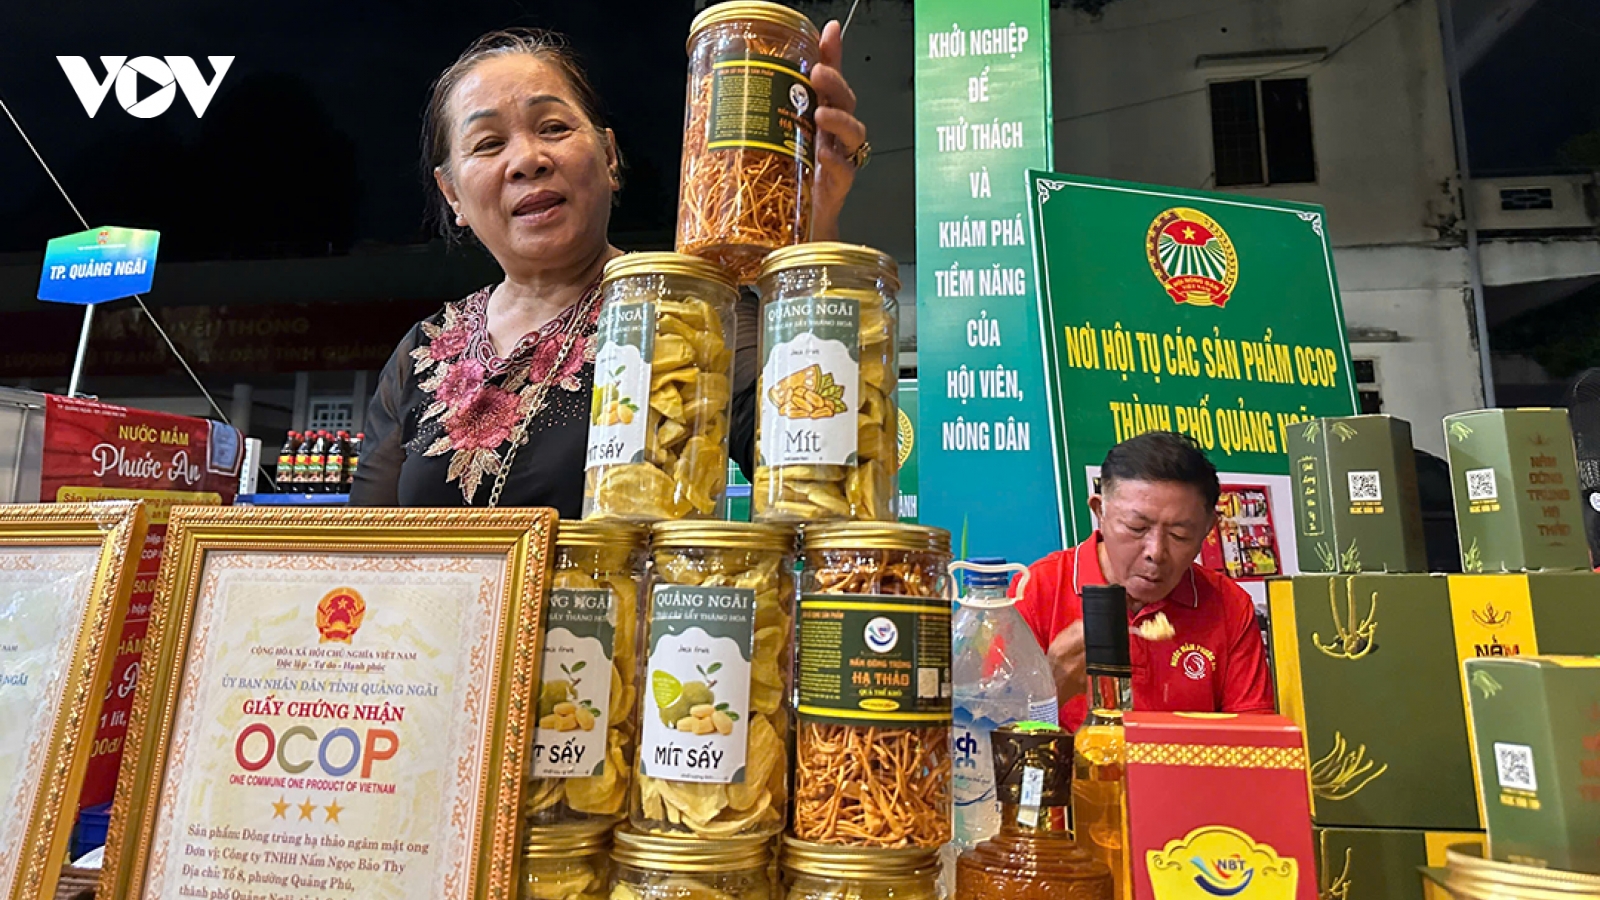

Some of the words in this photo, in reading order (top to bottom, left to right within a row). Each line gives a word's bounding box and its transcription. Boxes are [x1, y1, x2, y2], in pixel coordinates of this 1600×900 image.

[929, 22, 967, 59] KHỞI
[970, 21, 1029, 58] NGHIỆP
[968, 65, 990, 104] ĐỂ
[936, 116, 969, 152] THỬ
[971, 118, 1024, 151] THÁCH
[969, 167, 992, 198] VÀ
[939, 215, 988, 248] KHÁM
[990, 213, 1026, 247] PHÁ
[50, 265, 66, 281] TP.
[68, 259, 113, 280] QUẢNG
[978, 262, 1026, 297] NĂNG
[966, 309, 1001, 347] CỦA
[1101, 321, 1136, 381] HỘI
[1136, 336, 1161, 384] TỤ
[1163, 327, 1200, 378] CÁC
[1202, 326, 1242, 381] SẢN
[1241, 327, 1295, 385] PHẨM
[1295, 345, 1338, 388] OCOP
[946, 364, 977, 404] HỘI
[979, 364, 1024, 402] VIÊN,
[119, 424, 157, 443] NƯỚC
[160, 427, 189, 446] MẮM
[941, 416, 991, 451] NÔNG
[993, 416, 1031, 451] DÂN
[1174, 394, 1214, 451] PHỐ
[1215, 398, 1277, 456] QUẢNG
[599, 435, 625, 459] SẤY
[784, 429, 822, 453] Mít
[91, 443, 164, 478] Phước
[168, 450, 201, 486] An
[657, 590, 703, 608] QUẢNG
[708, 593, 748, 609] NGÃI
[398, 652, 417, 660] NAM
[222, 673, 239, 688] ỦY
[239, 677, 264, 691] BAN
[265, 677, 299, 691] NHÂN
[301, 678, 328, 693] DÂN
[330, 680, 359, 694] TỈNH
[361, 680, 404, 697] QUẢNG
[406, 683, 439, 697] NGÃI
[852, 671, 870, 687] HẠ
[874, 670, 909, 687] THẢO
[243, 695, 284, 716] GIẤY
[287, 698, 349, 719] CHỨNG
[353, 701, 406, 724] NHẬN
[235, 723, 400, 779] OCOP
[549, 736, 586, 763] SẤY
[654, 742, 684, 767] MÍT
[686, 740, 725, 770] SẤY
[229, 774, 247, 785] ONE
[247, 775, 287, 788] COMMUNE
[288, 777, 305, 789] ONE
[306, 779, 345, 792] PRODUCT
[346, 781, 359, 792] OF
[359, 782, 397, 795] VIETNAM
[187, 824, 207, 838] Sản
[242, 828, 271, 844] Đông
[272, 831, 303, 847] trùng
[304, 833, 318, 849] hạ
[321, 834, 346, 848] thảo
[381, 839, 404, 854] mật
[406, 842, 429, 855] ong
[184, 844, 205, 858] Đơn
[222, 847, 249, 864] Công
[251, 850, 262, 864] ty
[262, 851, 299, 865] TNHH
[300, 853, 326, 868] Nấm
[327, 855, 356, 871] Ngọc
[358, 857, 381, 872] Bảo
[383, 860, 407, 875] Thy
[1217, 858, 1248, 872] NBT
[179, 885, 208, 899] thành
[181, 864, 200, 880] Địa
[221, 866, 236, 880] Tổ
[247, 870, 291, 887] phường
[291, 873, 328, 889] Quảng
[328, 876, 356, 892] Phú,
